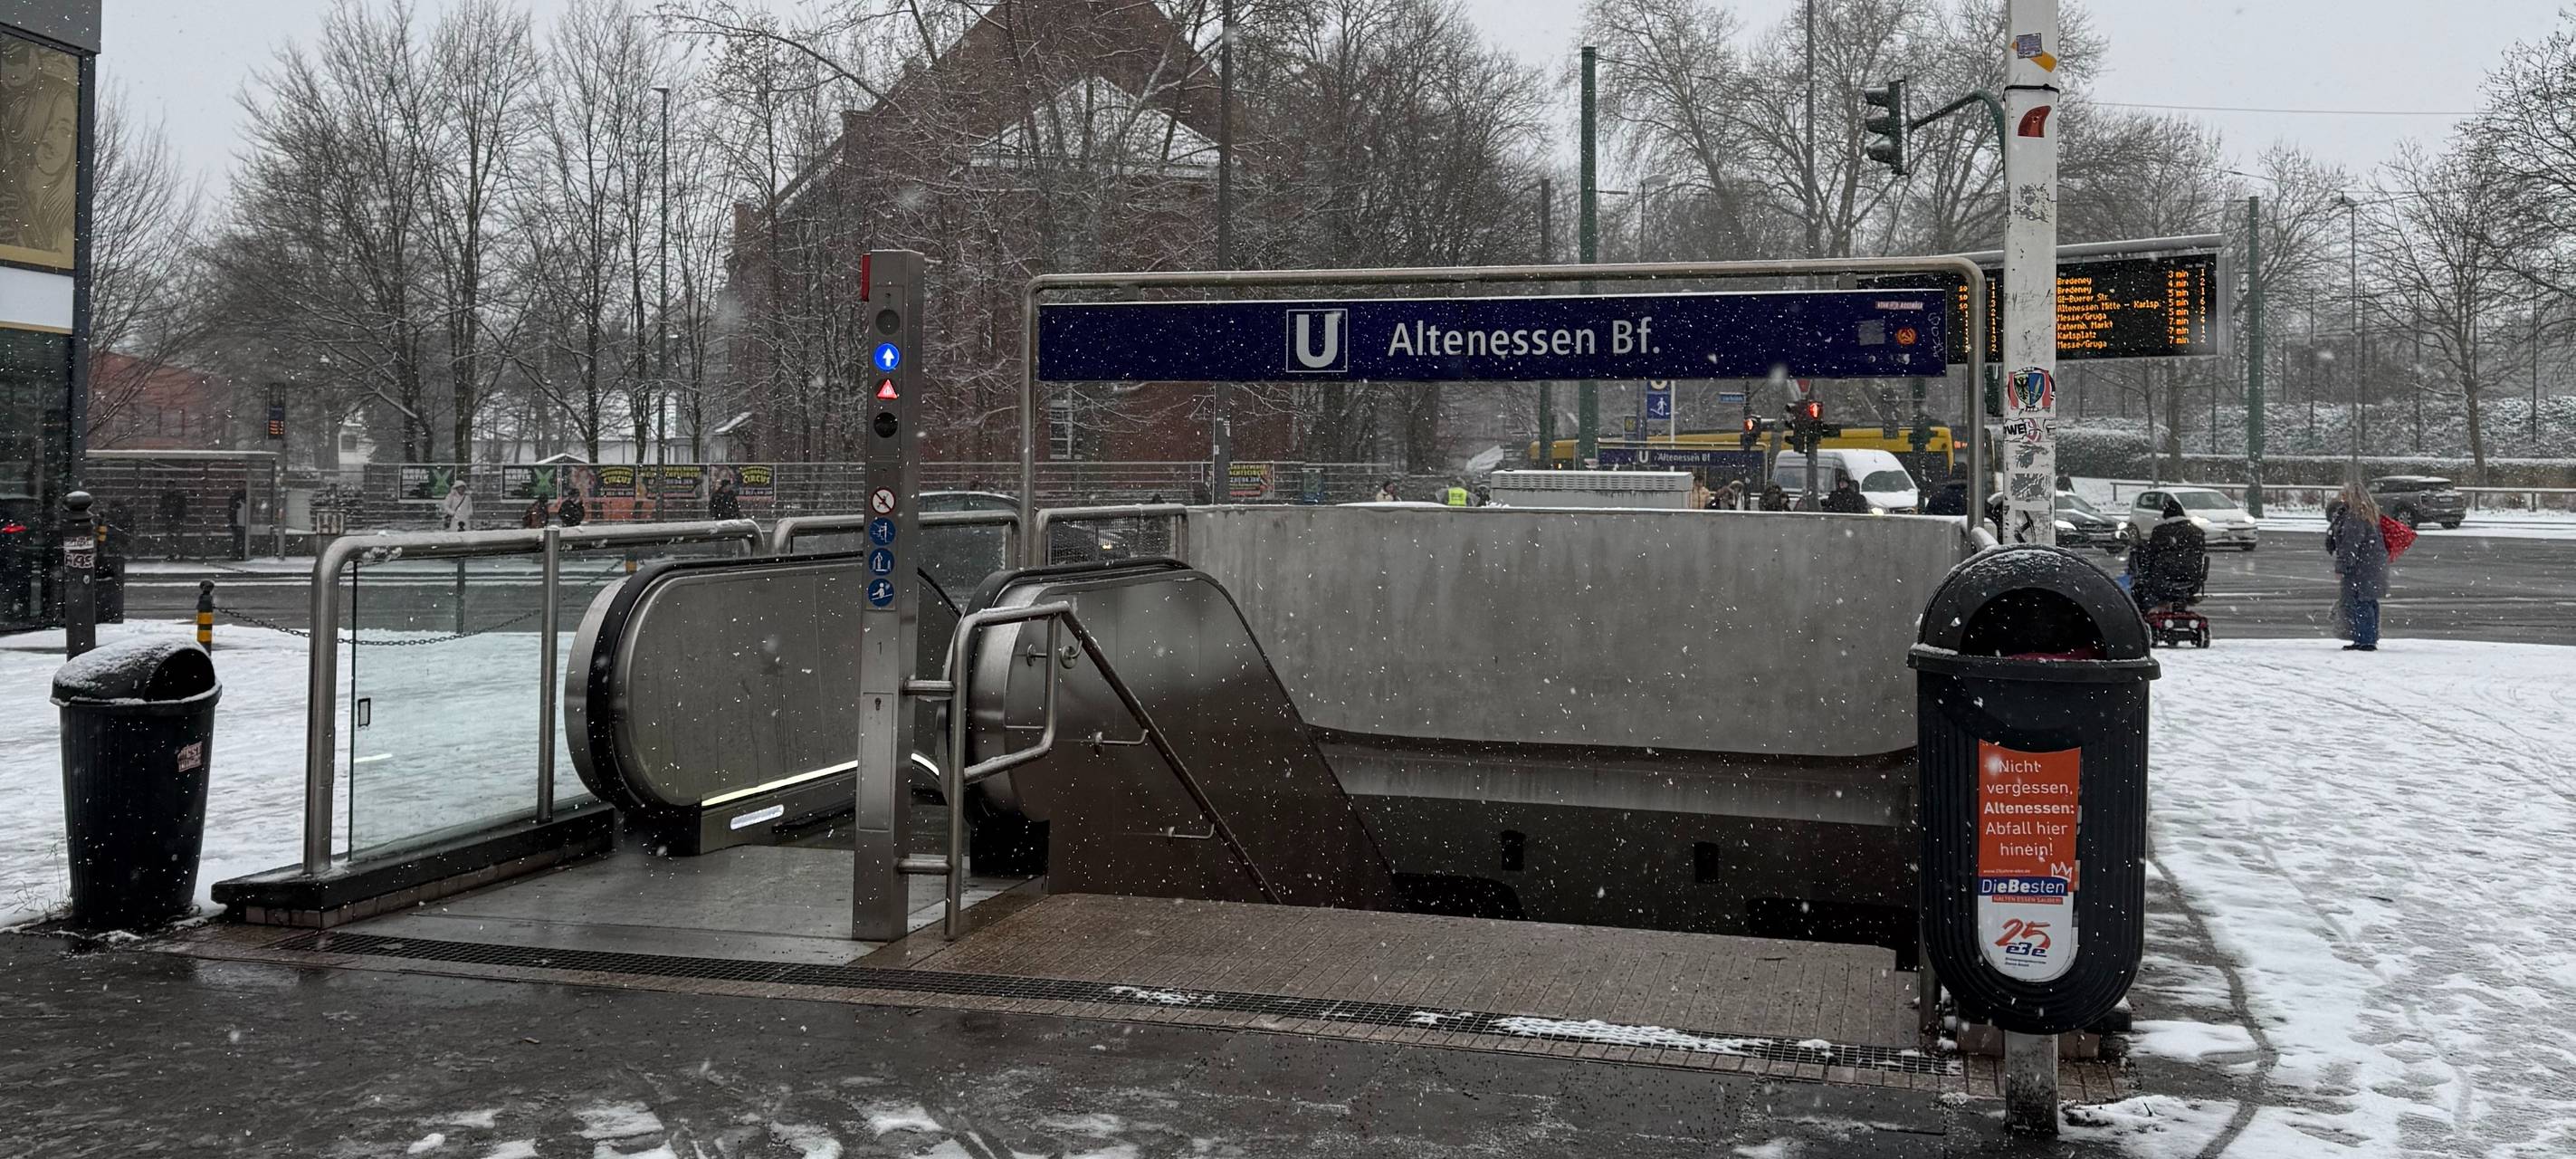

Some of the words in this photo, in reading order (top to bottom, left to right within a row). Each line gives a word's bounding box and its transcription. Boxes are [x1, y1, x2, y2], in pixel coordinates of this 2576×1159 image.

[2176, 270, 2189, 278] min
[2176, 279, 2189, 287] min
[2176, 289, 2189, 297] min
[2056, 304, 2099, 312] Altenessen
[2176, 298, 2189, 307] min
[2176, 308, 2189, 316] min
[2200, 307, 2205, 315] 2
[2091, 321, 2113, 329] Markt
[2176, 317, 2189, 326] min
[2057, 331, 2096, 340] Karlsplatz
[2176, 327, 2189, 335] min
[1296, 314, 1338, 368] U
[1388, 320, 1596, 356] Altenessen
[1612, 316, 1660, 354] Bf.
[2057, 340, 2107, 349] Messe/Gruga
[2176, 336, 2189, 344] min
[1639, 451, 1649, 463] U
[1658, 452, 1699, 462] Altenessen
[743, 475, 770, 484] CIRCUS
[1999, 761, 2040, 773] Nicht
[1987, 783, 2073, 797] vergessen,
[1984, 802, 2075, 814] Altenessen:
[1985, 821, 2032, 835] Abfall
[2037, 821, 2068, 835] hier
[2000, 843, 2053, 856] hinein!
[1982, 879, 2065, 893] DieBesten
[1994, 918, 2051, 950] 25
